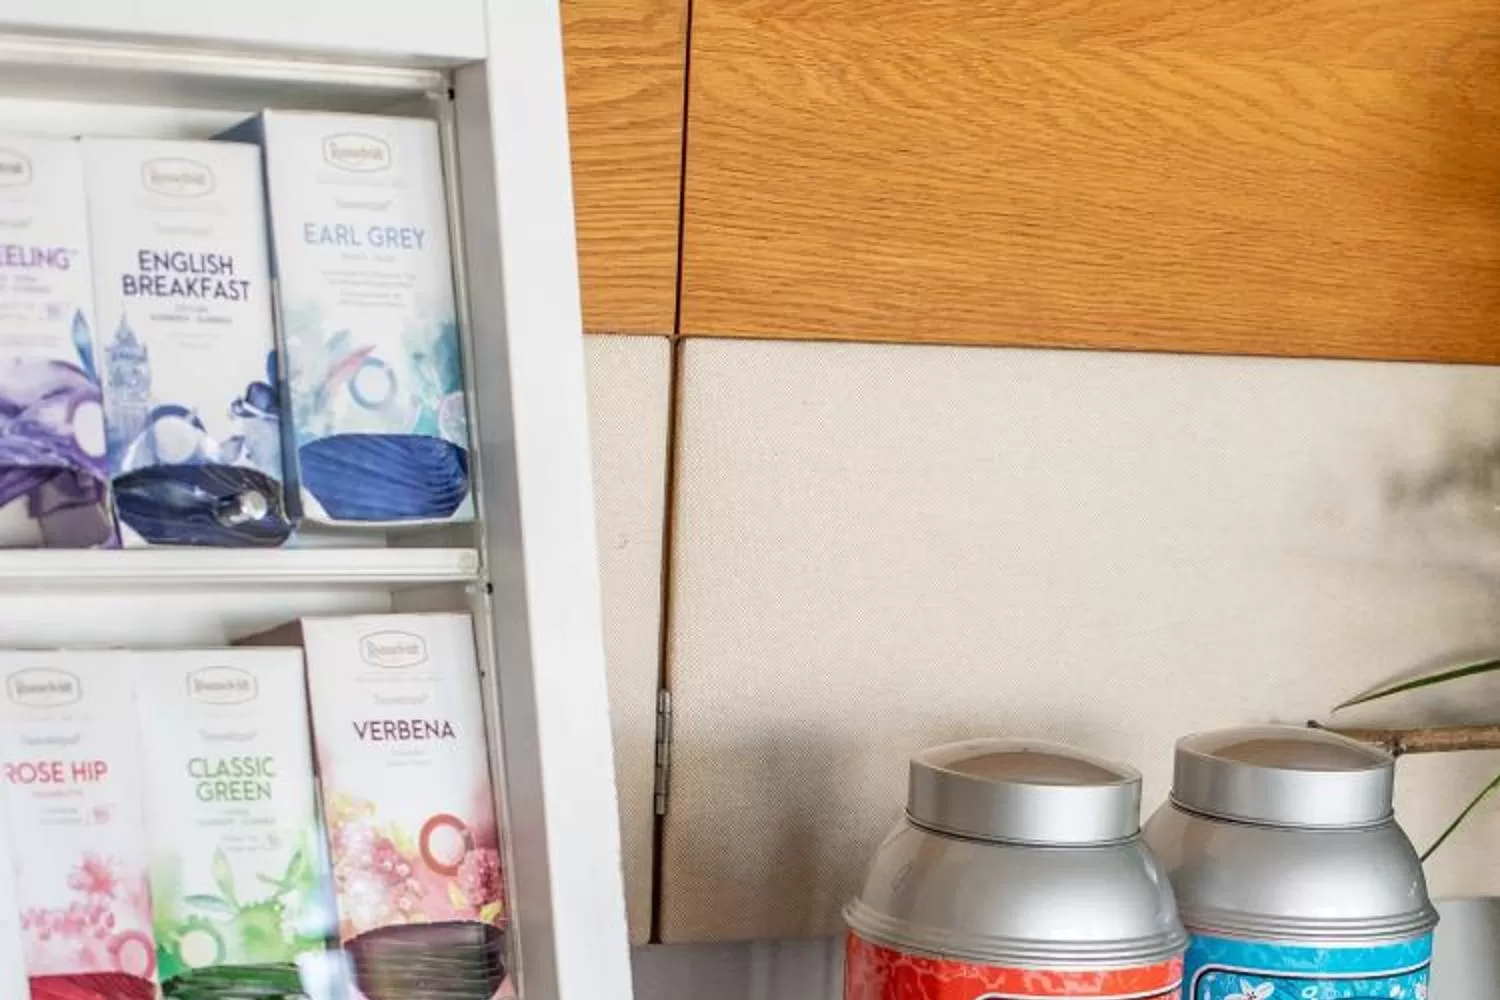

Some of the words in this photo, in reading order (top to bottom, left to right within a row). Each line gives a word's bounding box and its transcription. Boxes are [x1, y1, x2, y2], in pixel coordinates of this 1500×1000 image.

[303, 222, 362, 246] EARL
[367, 225, 426, 249] GREY
[138, 249, 234, 275] ENGLISH
[122, 273, 251, 301] BREAKFAST
[352, 719, 457, 741] VERBENA
[3, 761, 65, 784] ROSE
[71, 760, 108, 783] HIP
[187, 755, 276, 778] CLASSIC
[196, 780, 273, 802] GREEN
